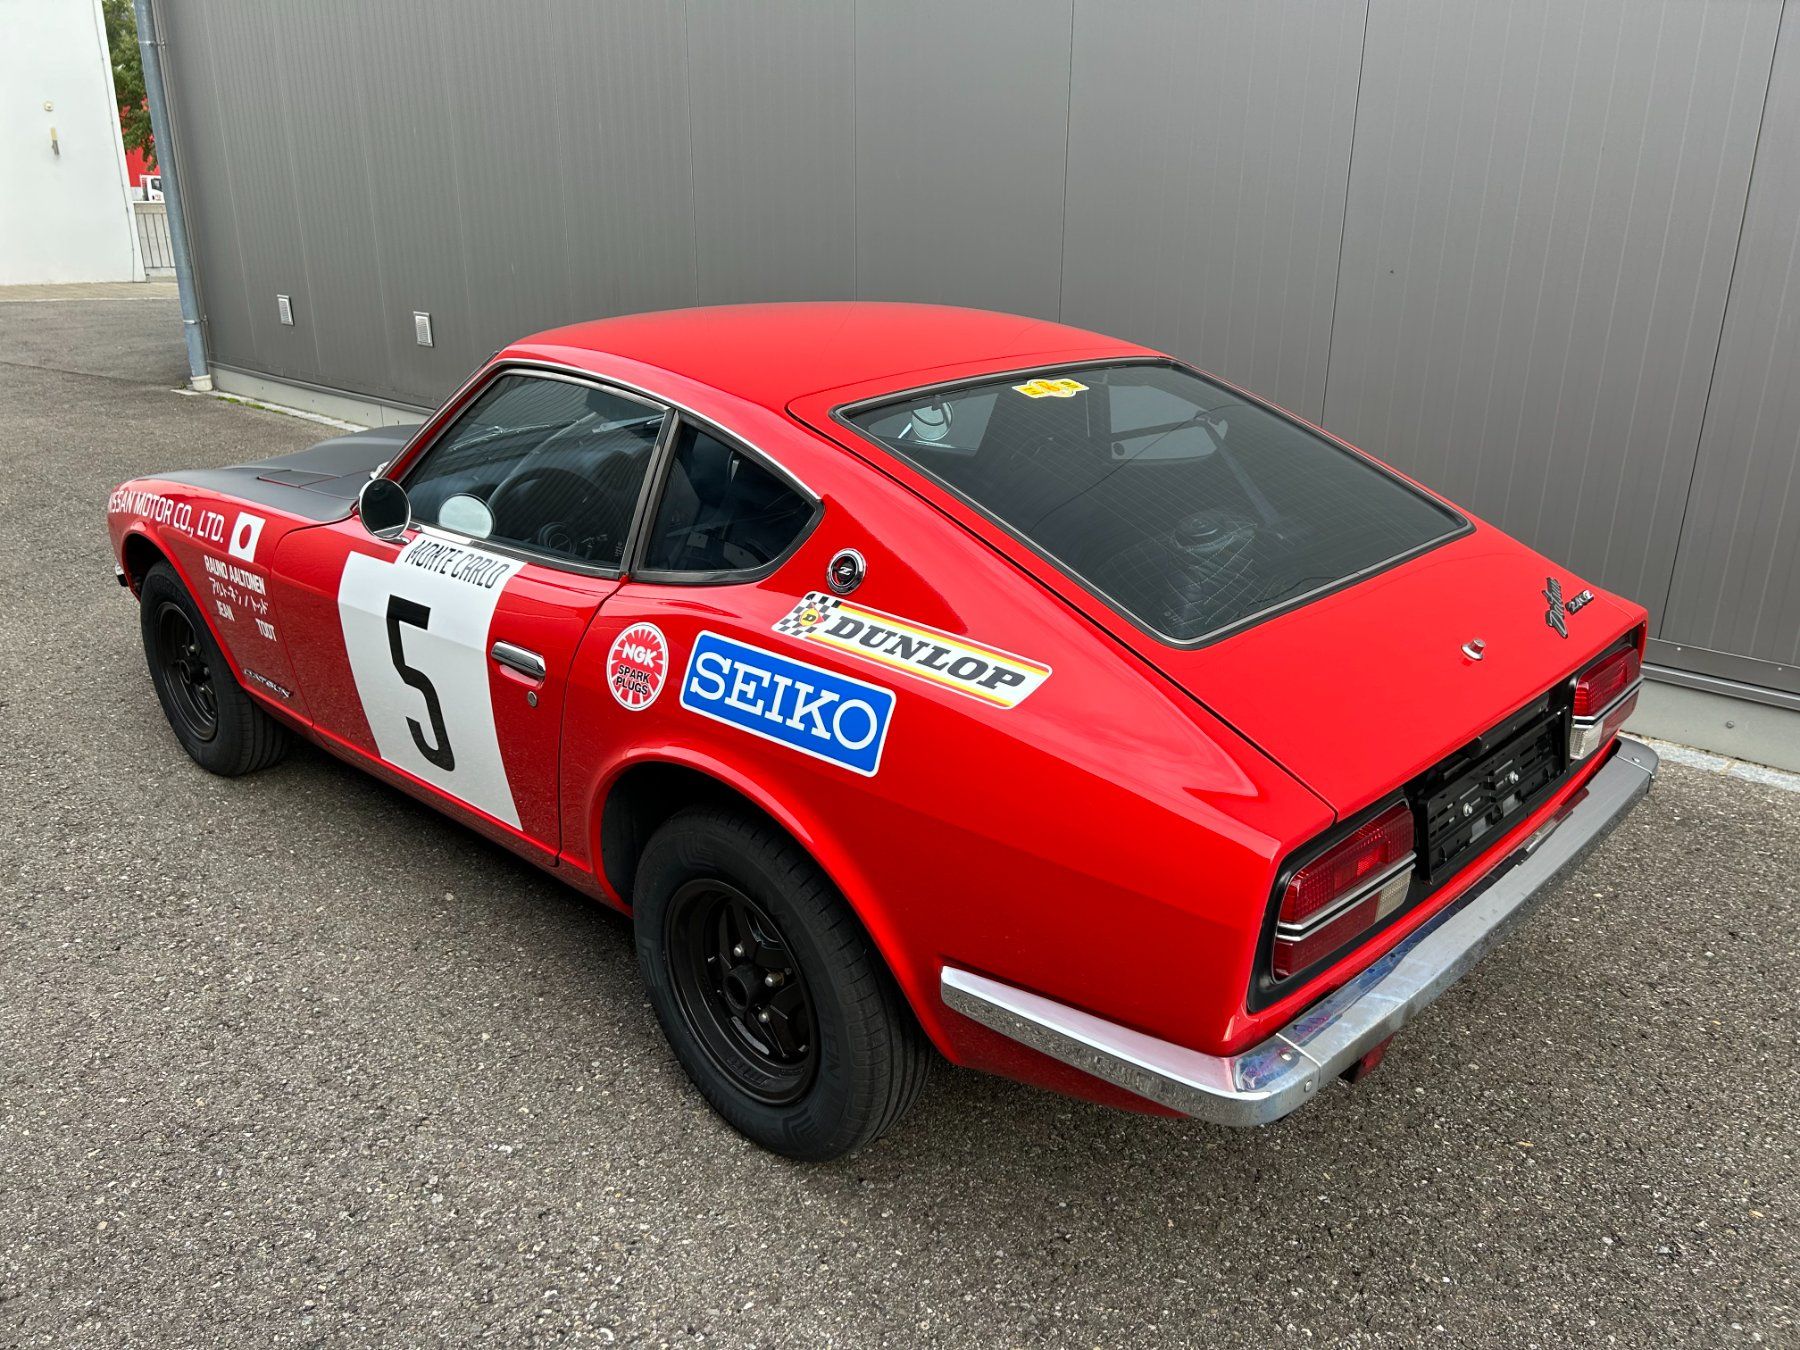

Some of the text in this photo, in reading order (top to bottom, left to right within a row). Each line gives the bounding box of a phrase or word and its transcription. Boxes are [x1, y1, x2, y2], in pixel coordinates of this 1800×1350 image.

[133, 491, 175, 525] MOTOR
[196, 509, 225, 543] LTD.
[404, 539, 510, 589] MONTE CARLO
[802, 613, 817, 622] D
[618, 664, 650, 684] SPARK
[621, 641, 658, 668] NGK
[824, 615, 1028, 691] DUNLOP
[385, 593, 456, 772] 5
[616, 676, 648, 695] PLUGS
[688, 651, 879, 751] SEIKO
